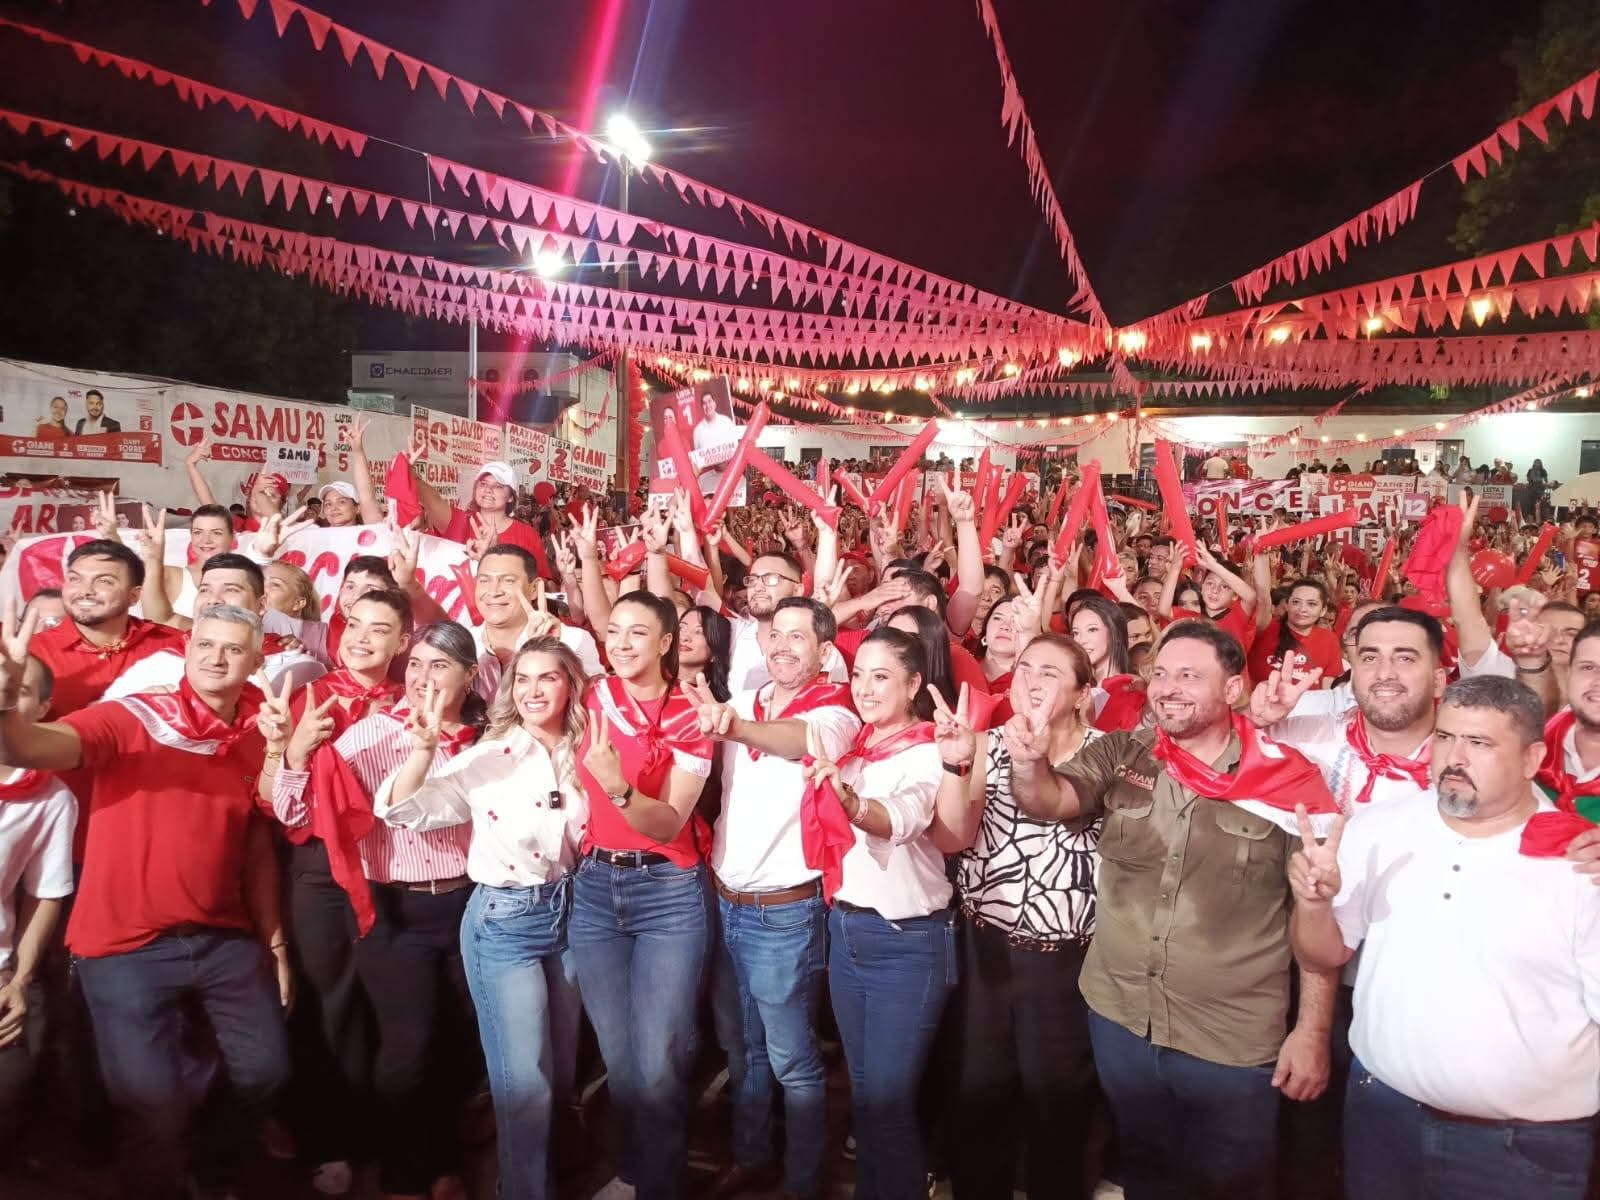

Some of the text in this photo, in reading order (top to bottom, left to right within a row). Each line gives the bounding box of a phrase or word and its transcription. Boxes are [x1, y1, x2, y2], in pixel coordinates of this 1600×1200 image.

[385, 367, 453, 376] CHACOMER
[211, 401, 326, 444] SAMU 20
[452, 417, 484, 441] DAVID
[278, 447, 311, 462] SAMU
[510, 436, 545, 454] ROMERO
[551, 440, 571, 450] LISTA
[338, 452, 348, 472] 5
[554, 448, 568, 468] 2
[573, 445, 607, 469] GIANI
[428, 463, 459, 484] GIANI
[1404, 500, 1429, 517] 12
[1127, 769, 1155, 785] GIANI
